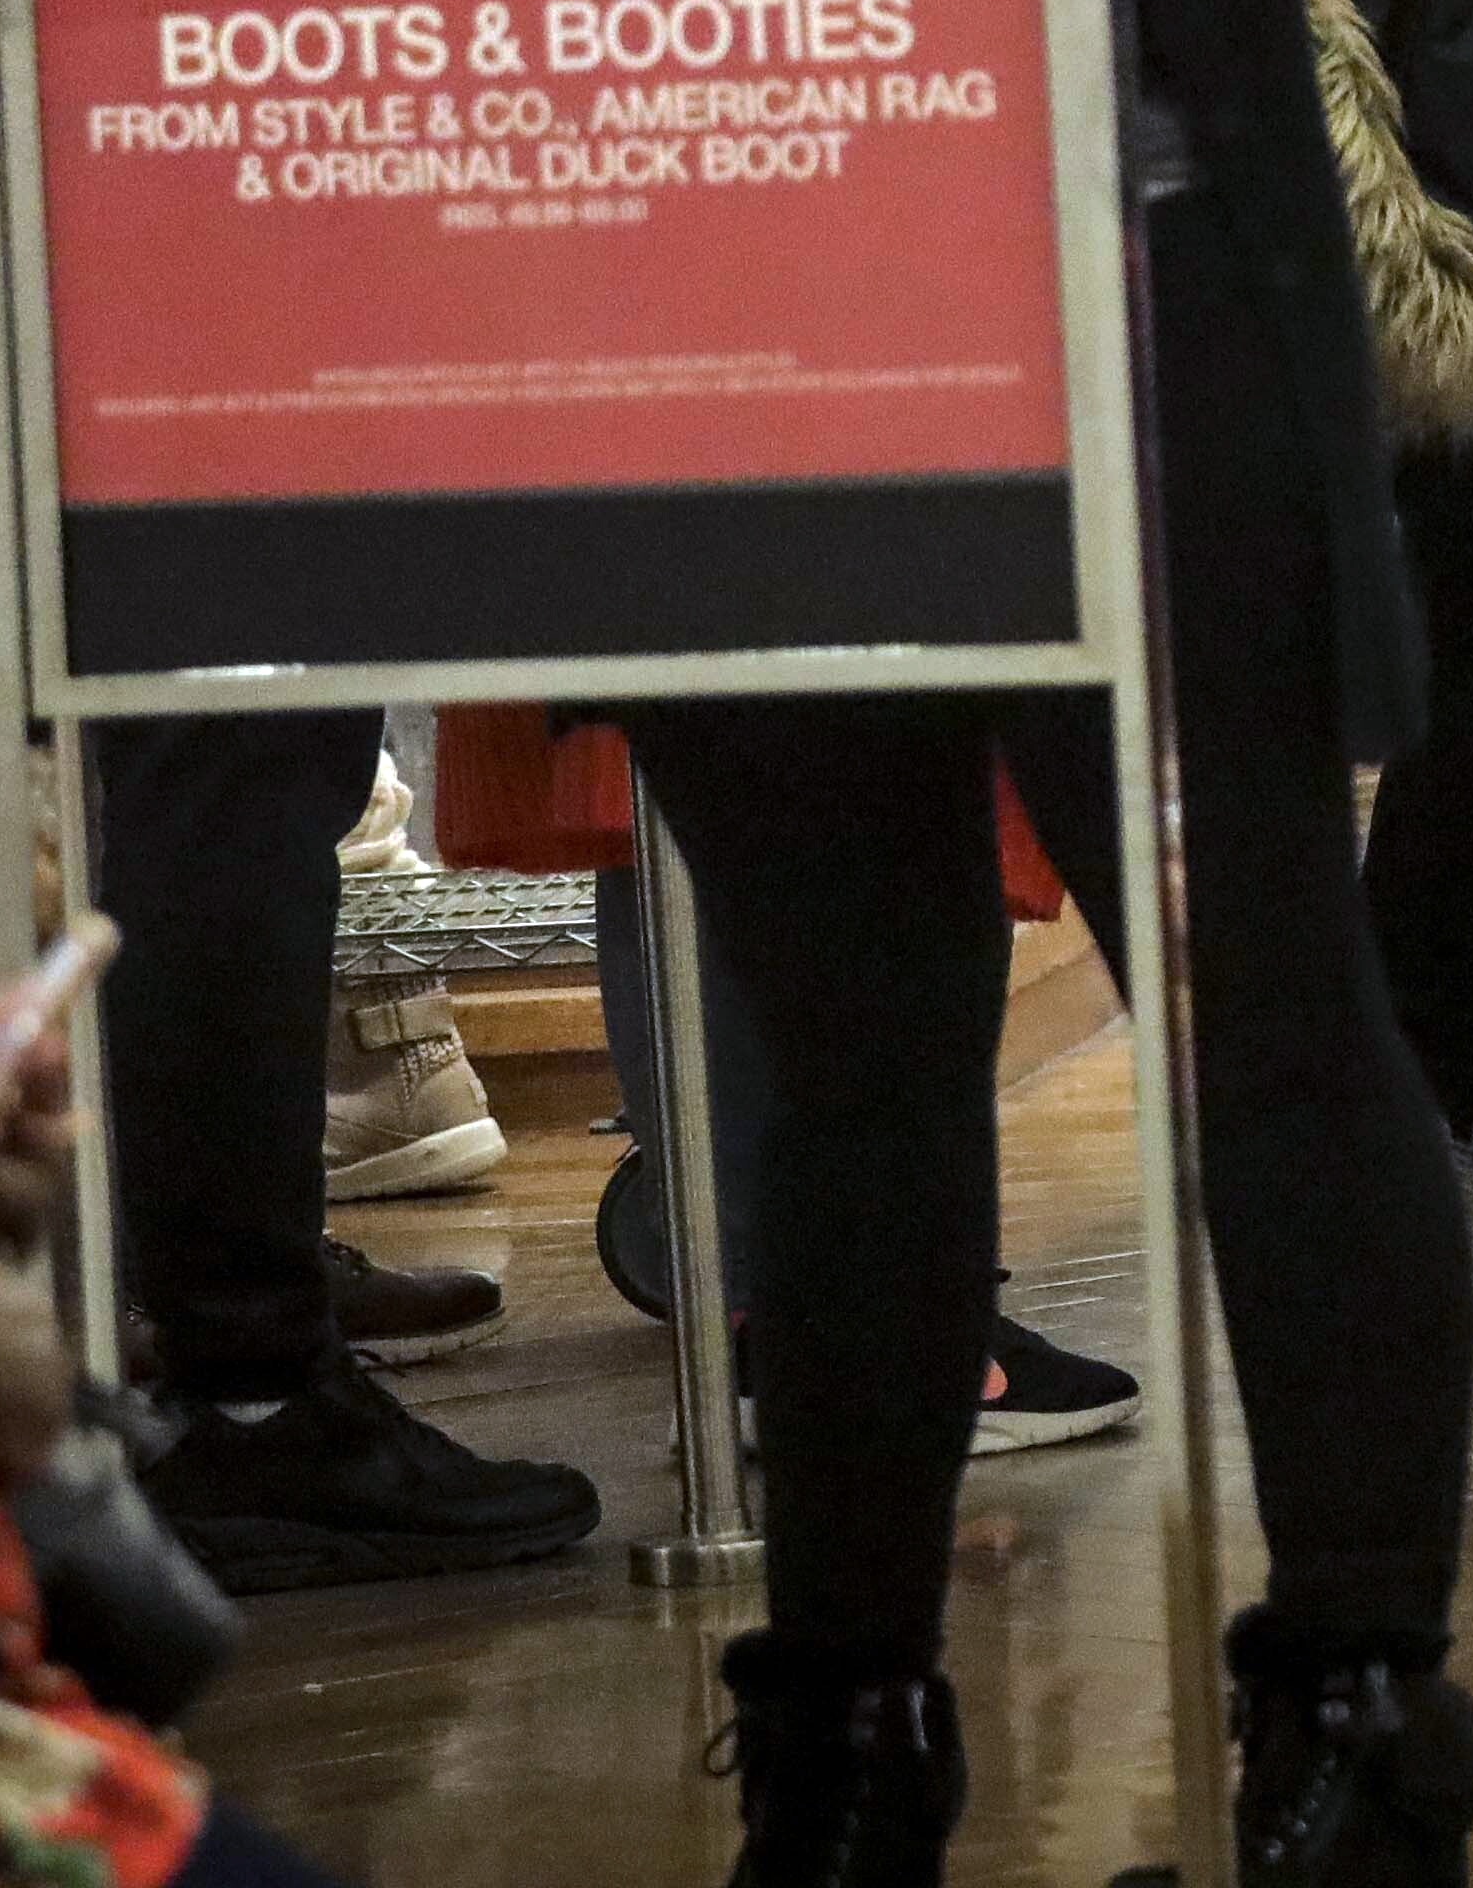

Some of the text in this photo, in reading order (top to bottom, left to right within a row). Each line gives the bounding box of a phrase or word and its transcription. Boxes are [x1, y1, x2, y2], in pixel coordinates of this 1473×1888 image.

[159, 2, 450, 89] BOOTS
[467, 0, 527, 78] &
[88, 99, 241, 153] FROM
[251, 93, 417, 148] STYLE
[426, 91, 463, 141] &
[589, 74, 869, 136] AMERICAN
[879, 68, 999, 122] RAG
[235, 129, 851, 202] & ORIGINAL DUCK BOOT
